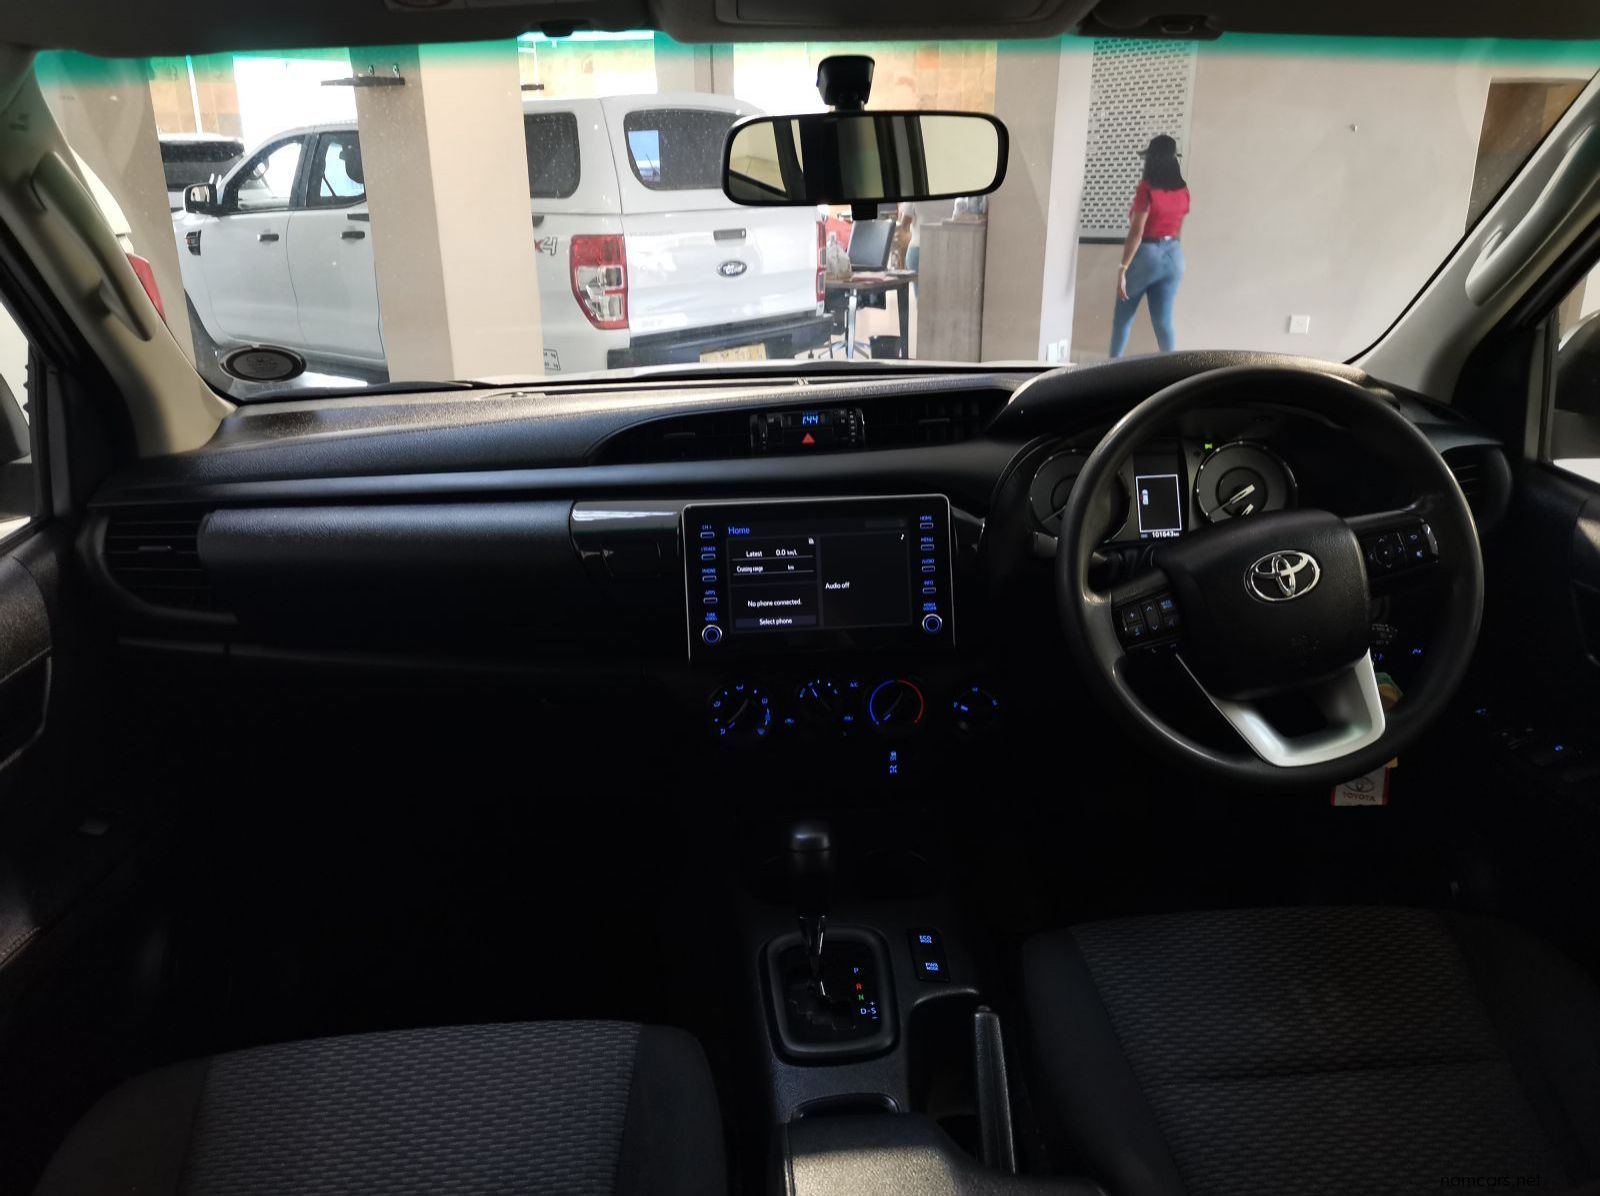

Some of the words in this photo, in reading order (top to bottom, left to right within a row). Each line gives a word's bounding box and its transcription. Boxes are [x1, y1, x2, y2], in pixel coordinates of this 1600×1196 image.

[728, 526, 750, 535] Home
[842, 581, 850, 589] off
[757, 600, 773, 608] phone
[774, 598, 802, 606] connected.
[1342, 791, 1377, 802] TOYOTA
